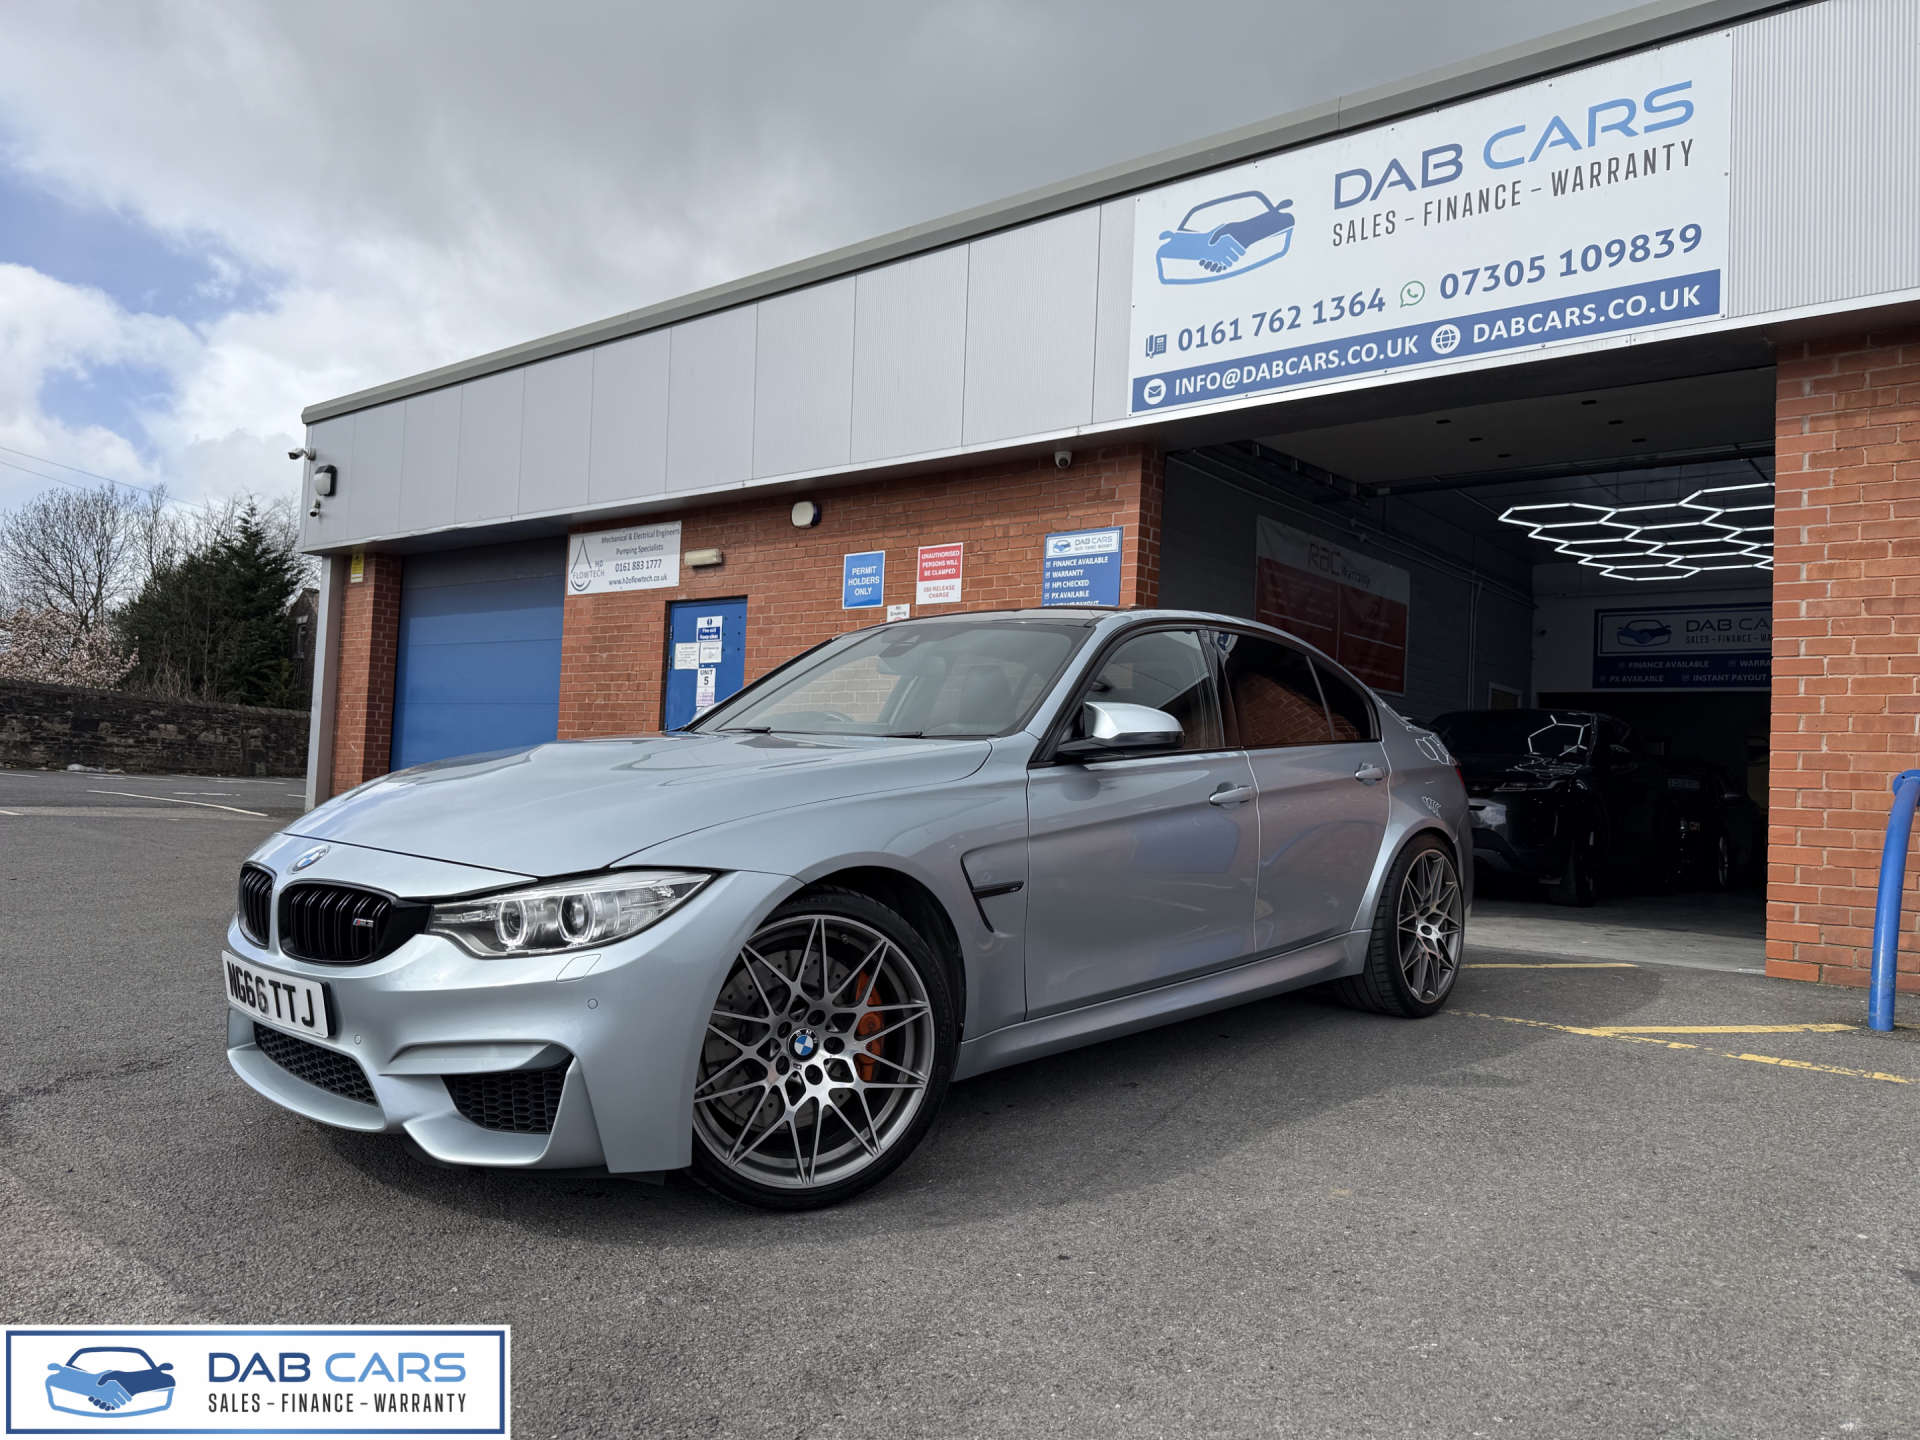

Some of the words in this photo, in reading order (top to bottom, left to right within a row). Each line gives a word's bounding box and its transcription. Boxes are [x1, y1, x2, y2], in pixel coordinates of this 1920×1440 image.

[1333, 142, 1463, 210] DAB
[1483, 80, 1695, 170] CARS
[1333, 208, 1398, 247] SALES
[1423, 180, 1522, 227] FINANCE
[1550, 138, 1695, 197] WARRANTY
[1439, 255, 1547, 299] 07305
[1558, 222, 1703, 277] 109839
[1177, 317, 1241, 352] 0161
[1252, 305, 1302, 336] 762
[1311, 287, 1386, 324] 1364
[1472, 284, 1701, 344] DABCARS.CO.UK
[1174, 334, 1420, 397] INFO@DABCARS.CO.UK
[601, 533, 628, 544] Mechanical
[633, 530, 655, 540] Electrical
[1074, 538, 1091, 546] DAB
[1091, 535, 1113, 544] CARS
[616, 547, 638, 557] Pumping
[638, 543, 664, 554] Specialists
[921, 550, 960, 560] UNAUTHORISED
[615, 562, 630, 573] 0161
[631, 560, 644, 570] 883
[646, 558, 662, 569] 1777
[922, 560, 946, 568] PERSONS
[946, 558, 959, 567] WILL
[1052, 558, 1078, 568] FINANCE
[1078, 556, 1109, 566] AVAILABLE
[572, 569, 605, 580] FLOWTECH
[851, 565, 877, 576] PERMIT
[931, 568, 956, 577] CLAMPED
[1052, 569, 1084, 579] WARRANTY
[848, 576, 880, 587] HOLDERS
[1052, 581, 1062, 590] HPI
[1062, 579, 1089, 589] CHECKED
[854, 587, 872, 597] ONLY
[1051, 591, 1060, 600] PX
[1060, 589, 1090, 599] AVAILABLE
[1686, 618, 1732, 633] DAB
[1738, 616, 1771, 631] CA
[1718, 633, 1752, 643] FINANCE
[1628, 660, 1665, 669] FINANCE
[1665, 659, 1711, 669] AVAILABLE
[704, 676, 709, 686] 5
[1621, 674, 1664, 683] AVAILABLE
[1693, 673, 1730, 682] INSTANT
[1732, 671, 1767, 682] PAYOUT
